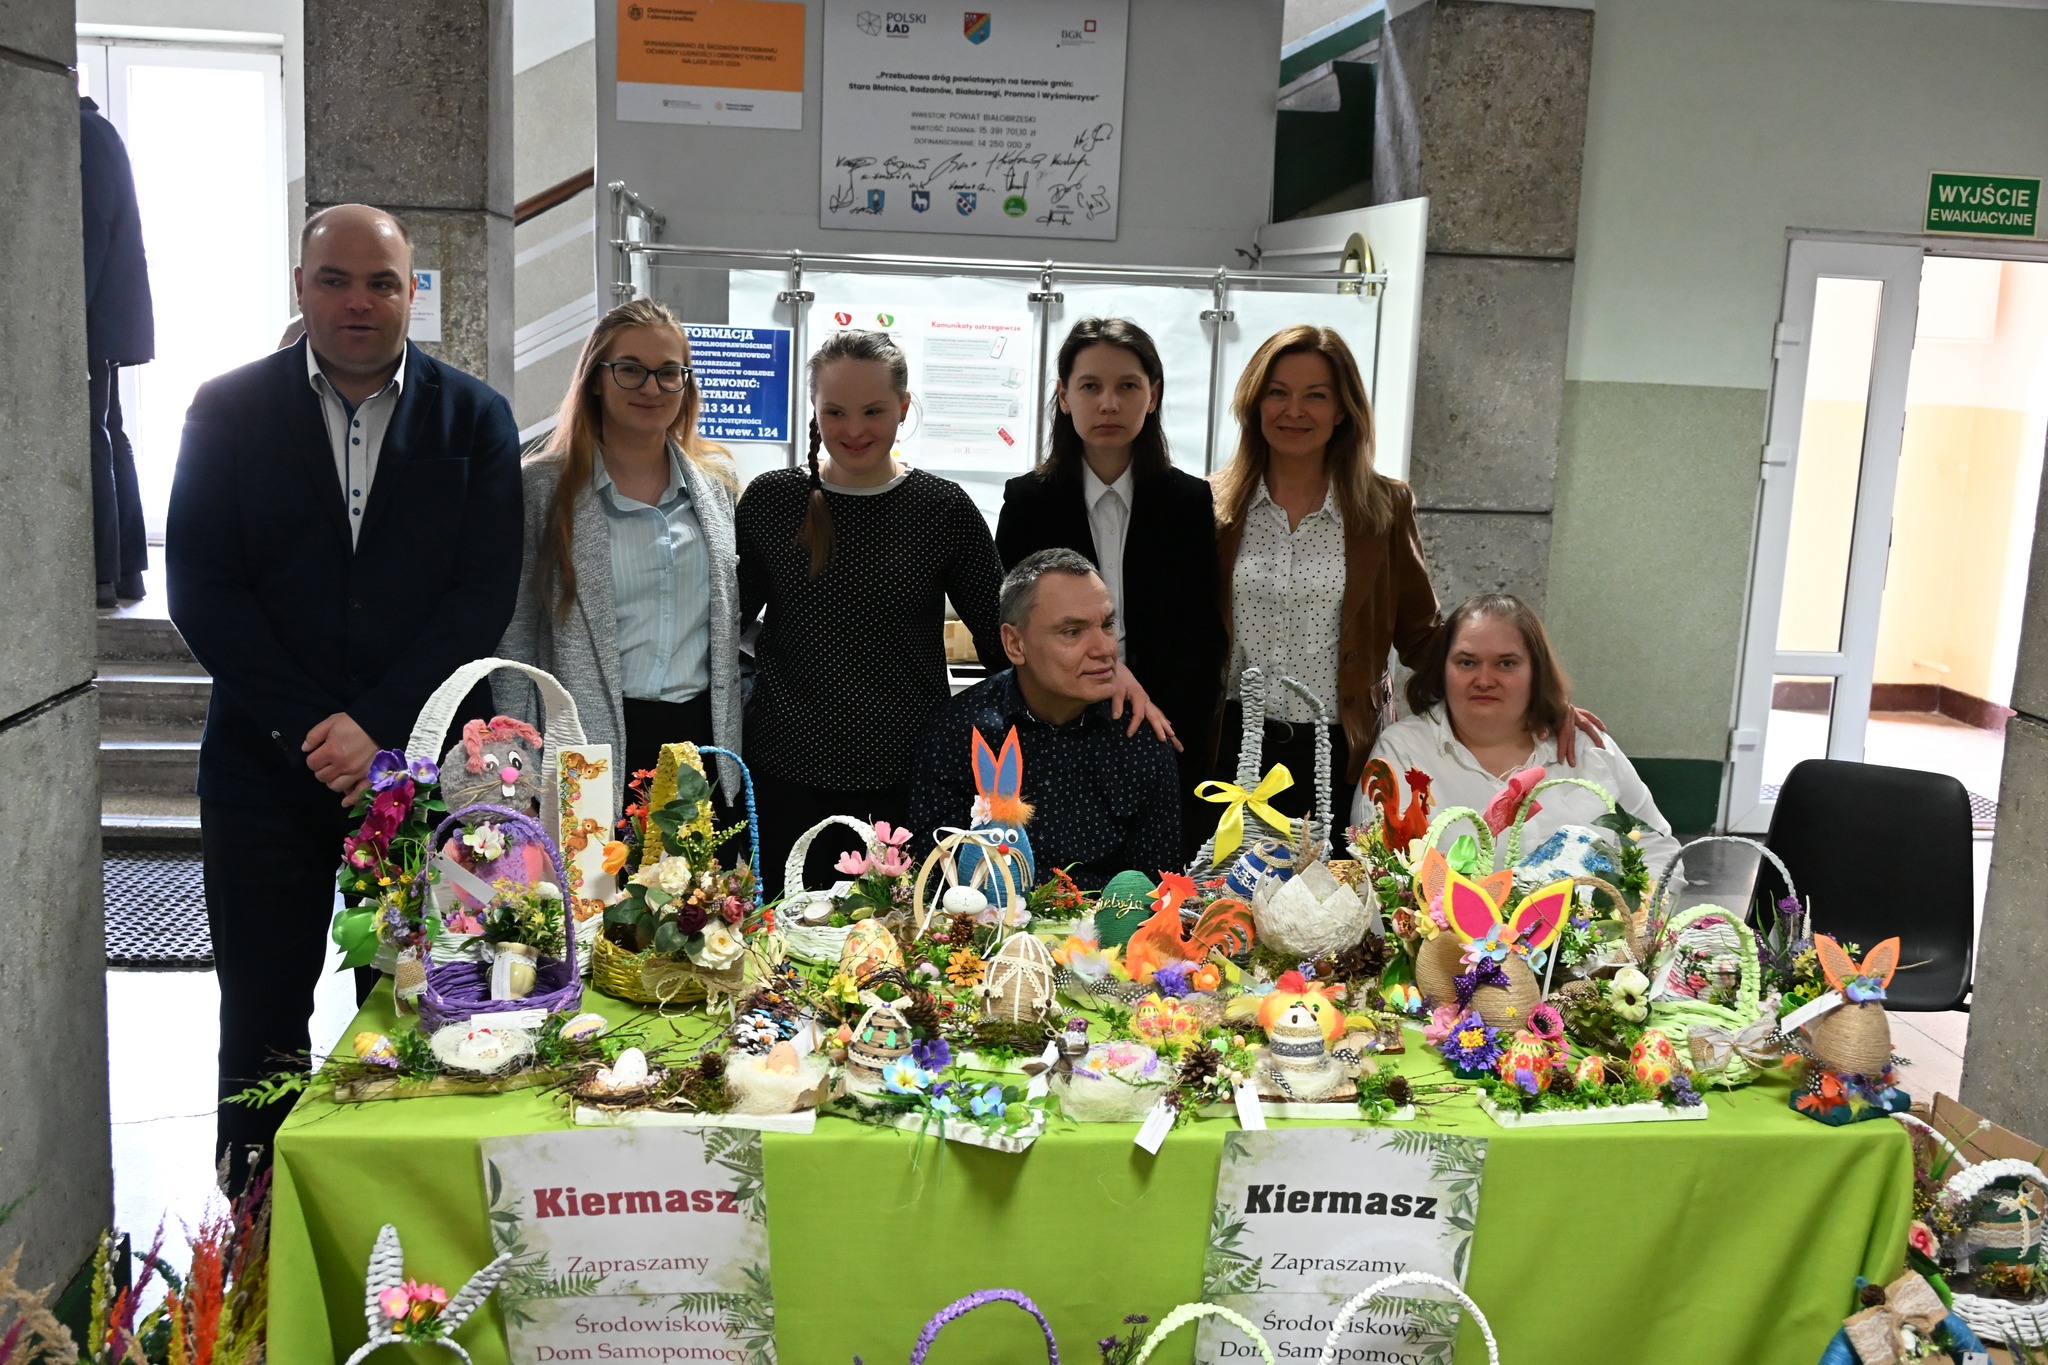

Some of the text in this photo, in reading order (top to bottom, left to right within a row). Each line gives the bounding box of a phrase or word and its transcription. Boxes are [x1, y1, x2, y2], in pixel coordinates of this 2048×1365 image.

[886, 12, 927, 24] POLSKI
[886, 24, 910, 34] ŁAD
[1061, 30, 1082, 40] BGK
[646, 48, 678, 56] OCHRONY
[740, 45, 778, 54] PROGRAMU
[932, 73, 951, 84] dróg
[952, 74, 1006, 86] powiatowych
[1020, 78, 1048, 86] terenie
[1050, 79, 1074, 89] gmin:
[848, 82, 870, 91] Stara
[872, 83, 908, 94] Błotnica,
[910, 85, 954, 96] Radzanów,
[955, 88, 1002, 99] Białobrzegi,
[1004, 90, 1036, 98] Promna
[948, 112, 981, 121] POWIAT
[983, 114, 1036, 123] BIAŁOBRZESKI
[910, 124, 944, 132] WARTOŚĆ
[946, 126, 976, 134] ZADANIA:
[979, 126, 986, 134] 15
[988, 126, 1002, 134] 391
[1030, 128, 1036, 136] zł
[914, 137, 1032, 150] DOFINANSOWANIE: 14 250 000 zł
[1938, 183, 2031, 207] WYJŚCIE
[1930, 208, 2033, 226] EWAKUACYJNE
[931, 320, 1021, 332] Komunikaty ostrzegawcze
[683, 327, 754, 342] FORMACJA
[704, 378, 760, 388] DZWONIĆ:
[720, 404, 735, 414] 34
[737, 404, 752, 414] 14
[709, 426, 723, 436] 14
[758, 427, 778, 438] 124
[532, 1187, 740, 1219] Kiermasz
[1244, 1183, 1438, 1220] Kiermasz
[567, 1255, 710, 1278] Zapraszamy
[1270, 1252, 1407, 1275] Zapraszamy
[574, 1313, 745, 1340] Środowiskowy
[536, 1342, 750, 1365] Dom Samopomocy
